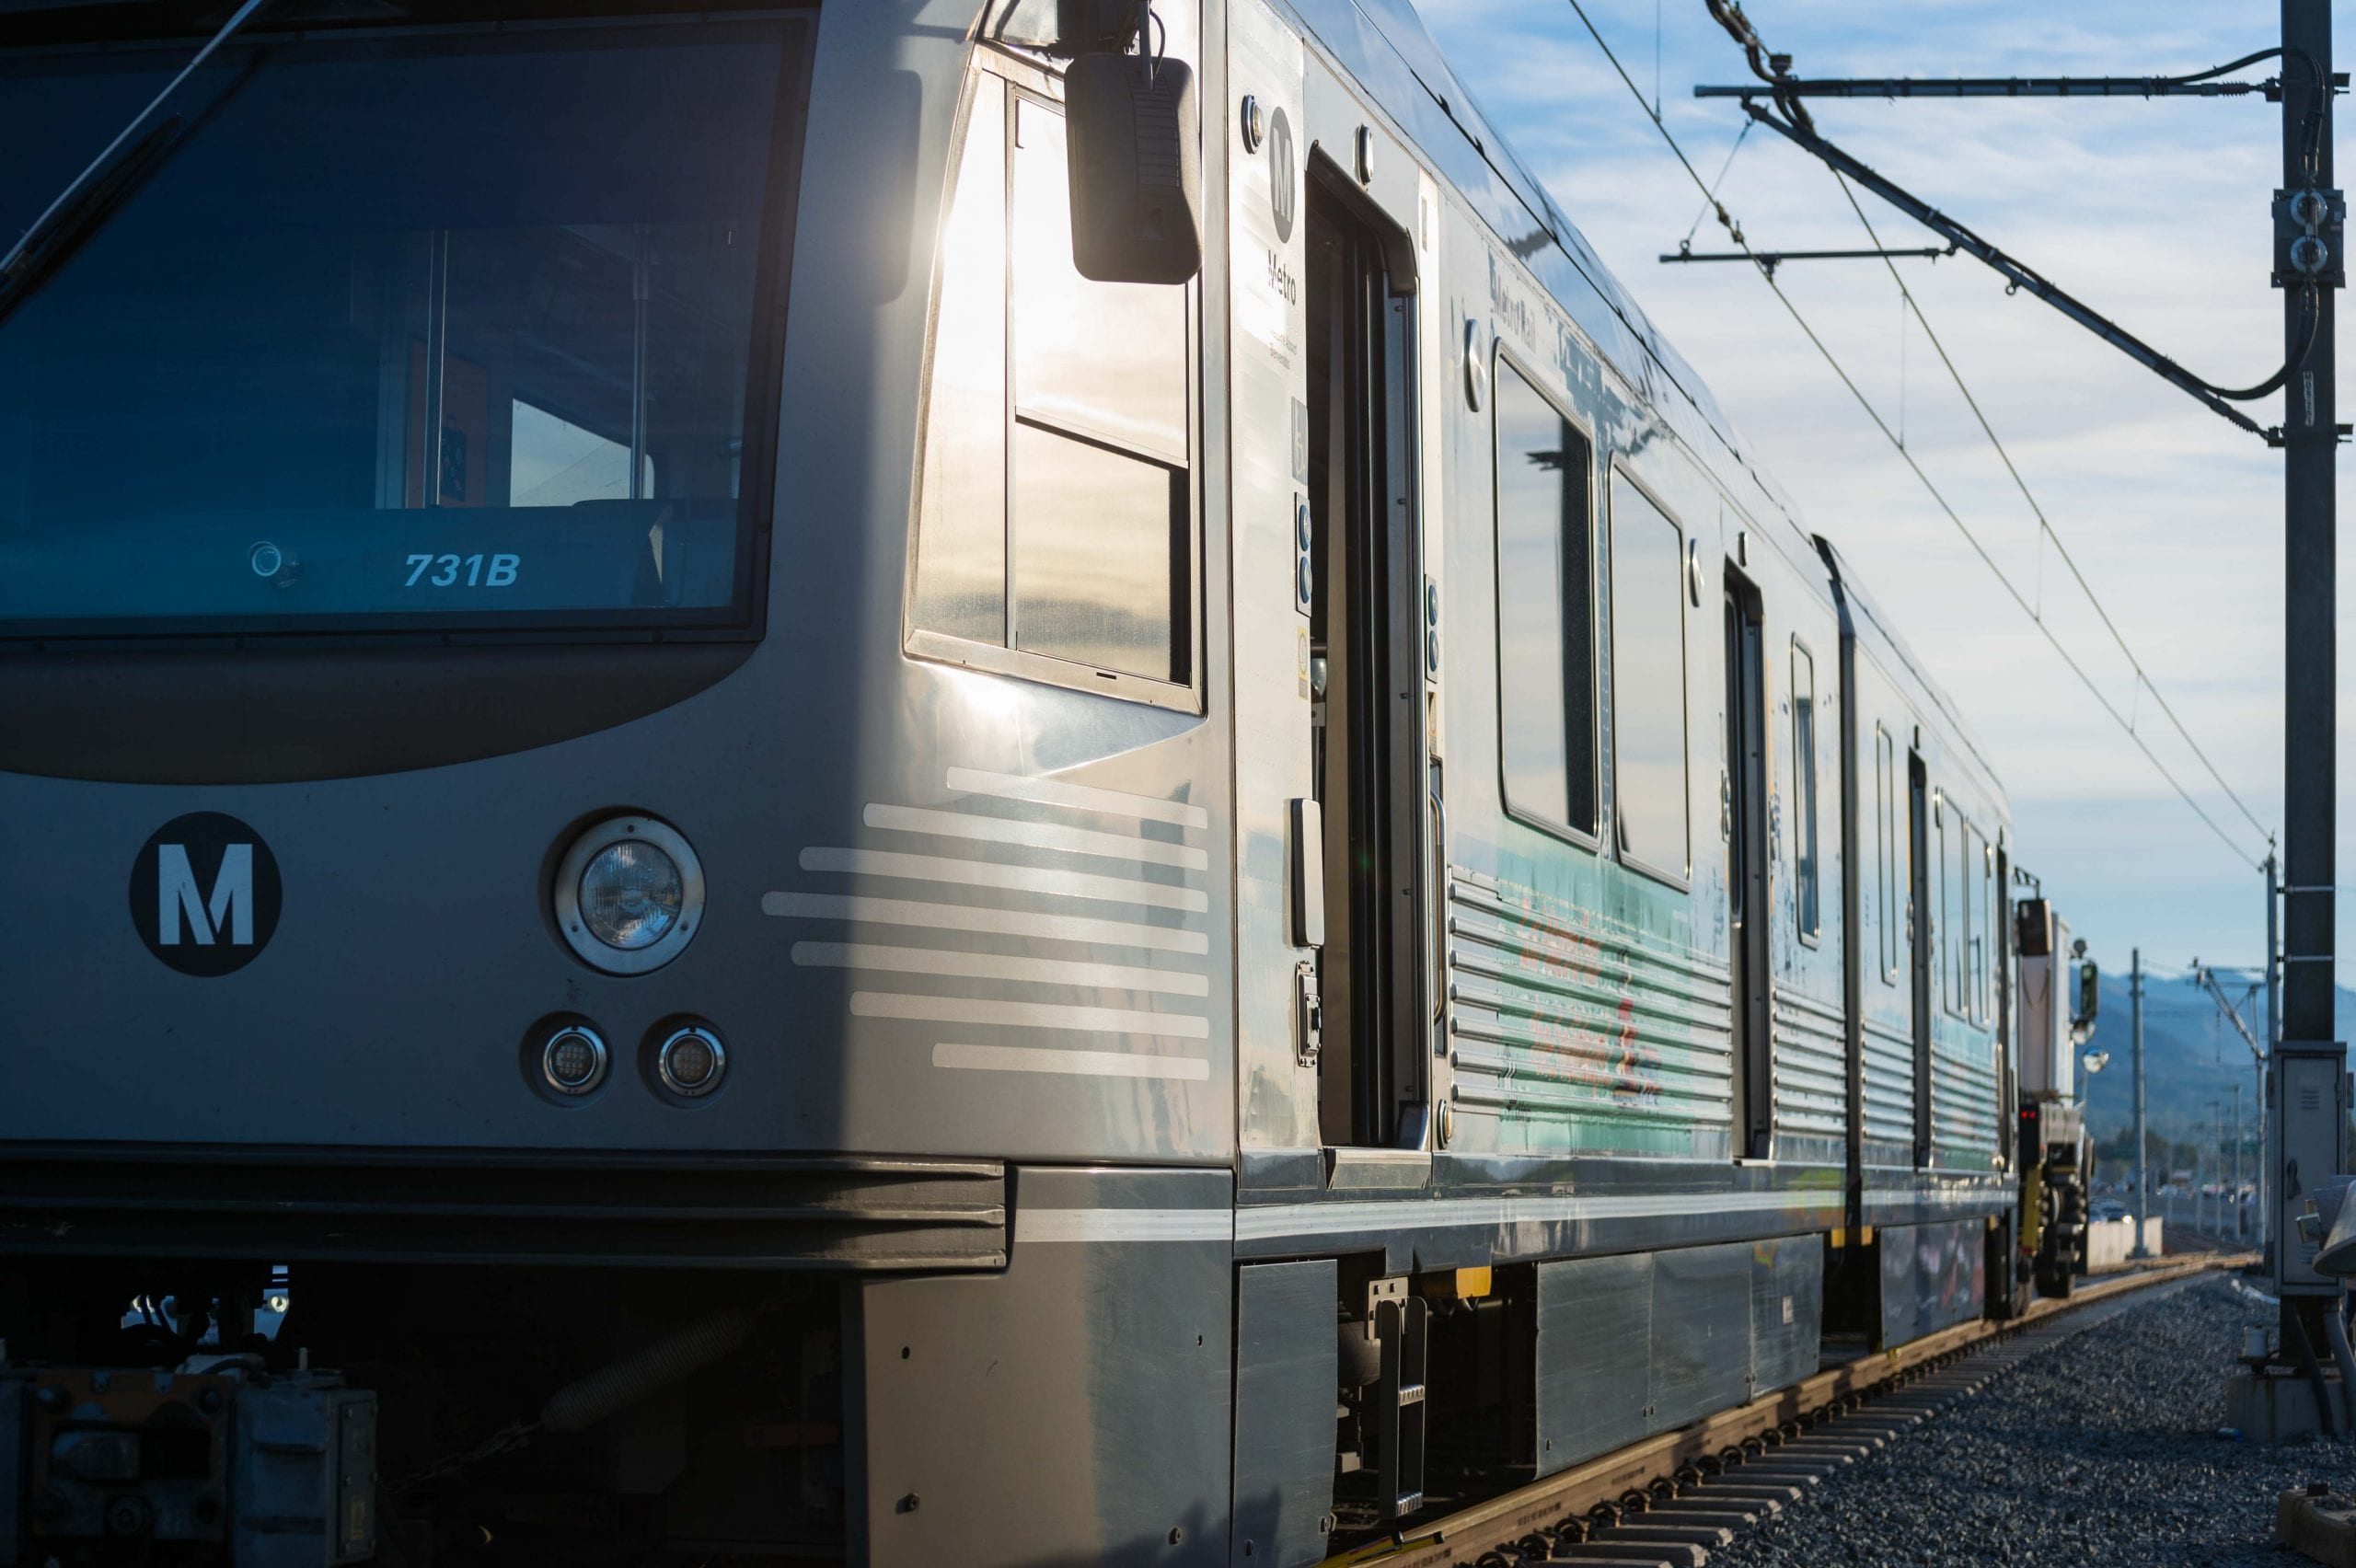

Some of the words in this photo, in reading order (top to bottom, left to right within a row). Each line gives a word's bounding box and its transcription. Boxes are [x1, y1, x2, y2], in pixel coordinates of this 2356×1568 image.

[1267, 248, 1297, 306] Metro
[405, 553, 521, 587] 731B
[158, 843, 254, 945] M
